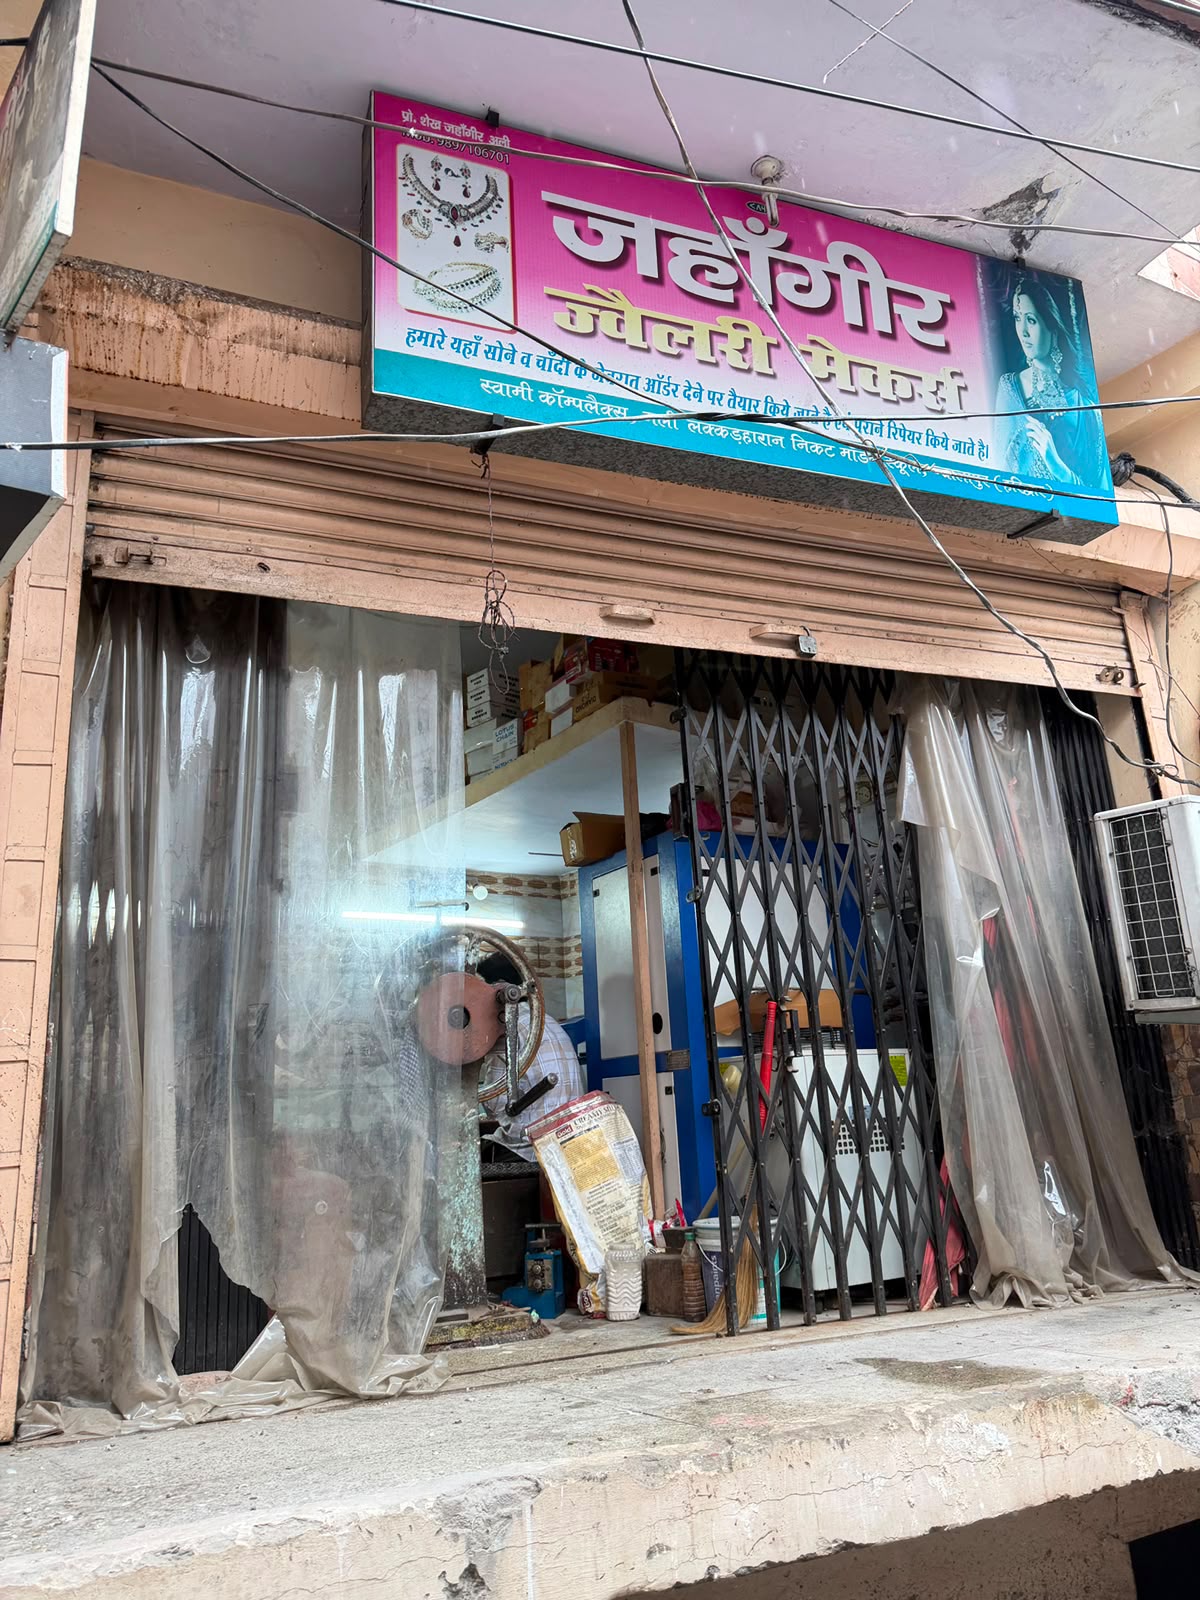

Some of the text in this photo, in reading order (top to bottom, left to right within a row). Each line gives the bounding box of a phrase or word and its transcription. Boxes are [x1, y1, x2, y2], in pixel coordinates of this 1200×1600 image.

[401, 109, 511, 149] प्रो. शेख जहाँगीर अली
[541, 190, 951, 348] जहाँगीर
[405, 327, 447, 350] हमारे
[450, 335, 483, 359] यहाँ
[484, 340, 518, 364] सोने
[521, 352, 533, 368] व
[643, 373, 681, 398] ऑर्डर
[683, 380, 704, 402] देने
[708, 390, 725, 407] पर
[728, 388, 761, 413] तैयार
[763, 395, 791, 417] किये
[886, 417, 923, 445] रिपेयर
[925, 428, 949, 451] किये
[952, 437, 975, 456] जाते
[543, 283, 966, 413] ज्वैलरी मेकर्स
[480, 379, 534, 403] स्वामी
[791, 433, 836, 458] निकट
[557, 1126, 572, 1138] Gold
